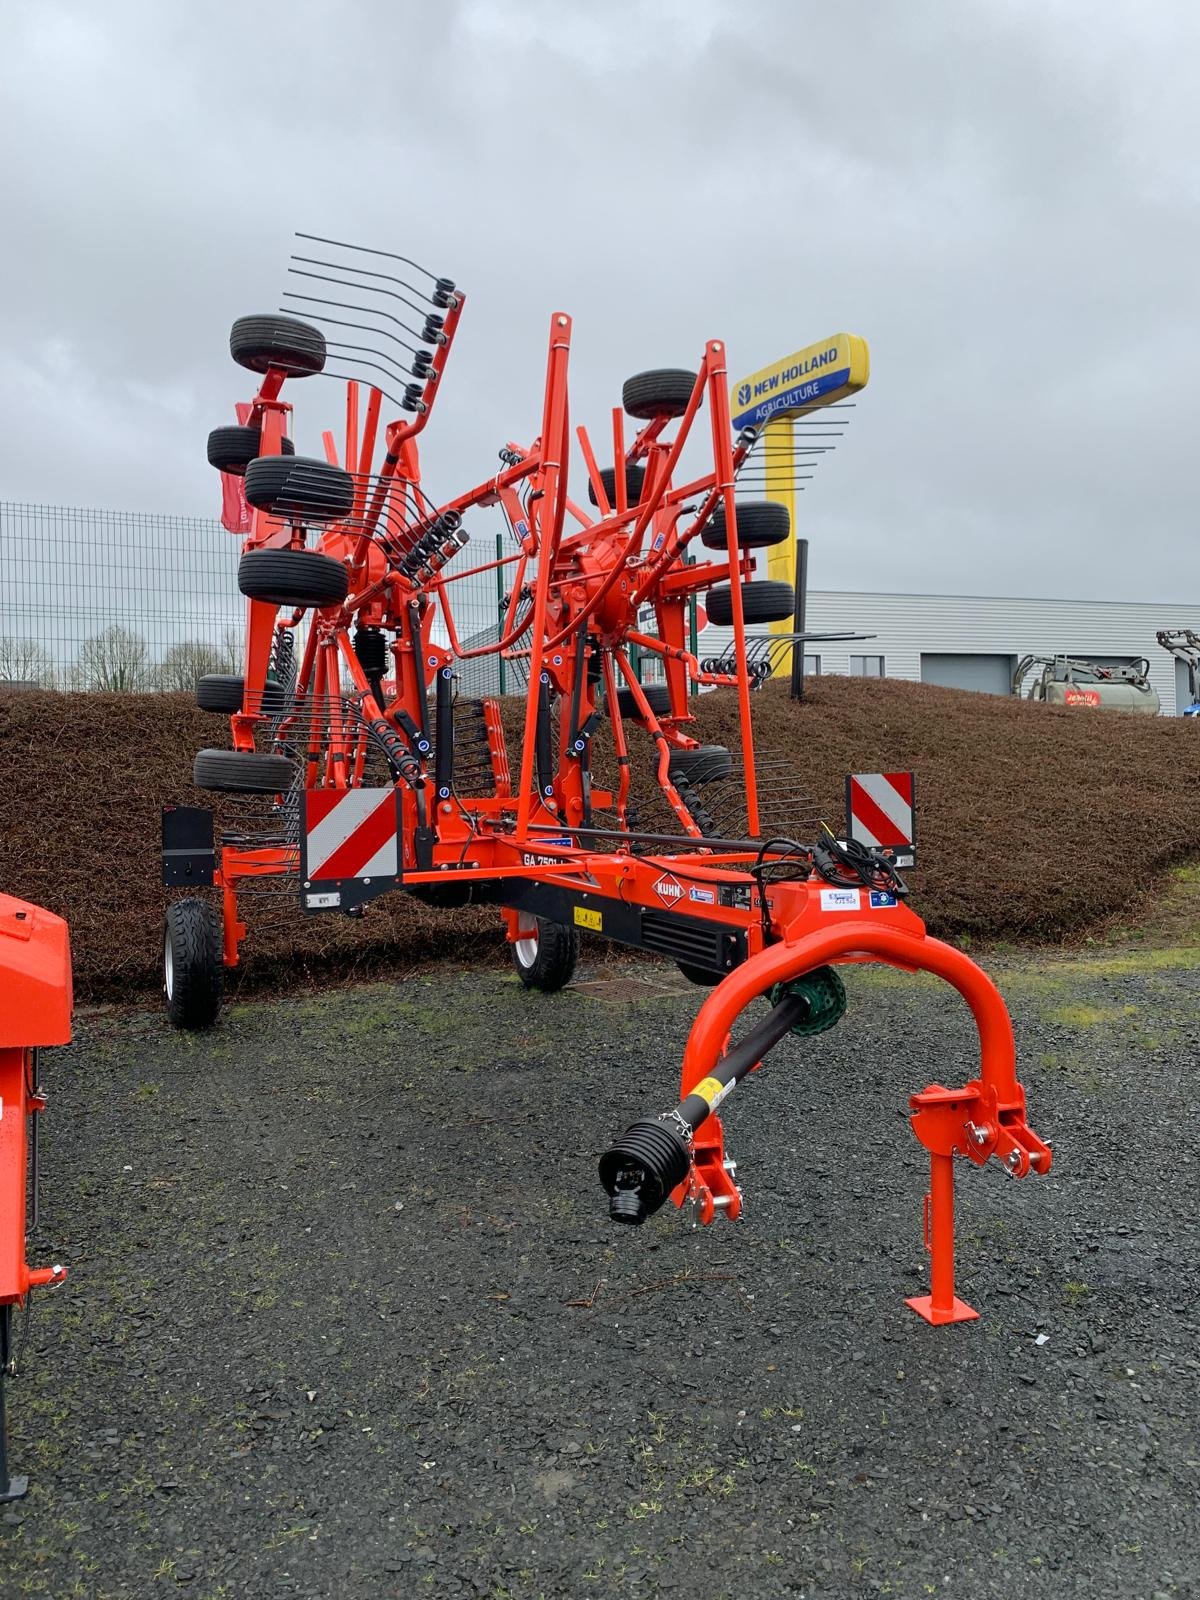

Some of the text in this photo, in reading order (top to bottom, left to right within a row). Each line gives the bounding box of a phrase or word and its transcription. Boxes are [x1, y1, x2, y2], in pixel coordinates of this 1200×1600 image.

[754, 347, 838, 397] NEW HOLLAND
[755, 381, 820, 421] AGRICULTURE
[523, 853, 535, 866] GA
[657, 882, 681, 898] KUHN
